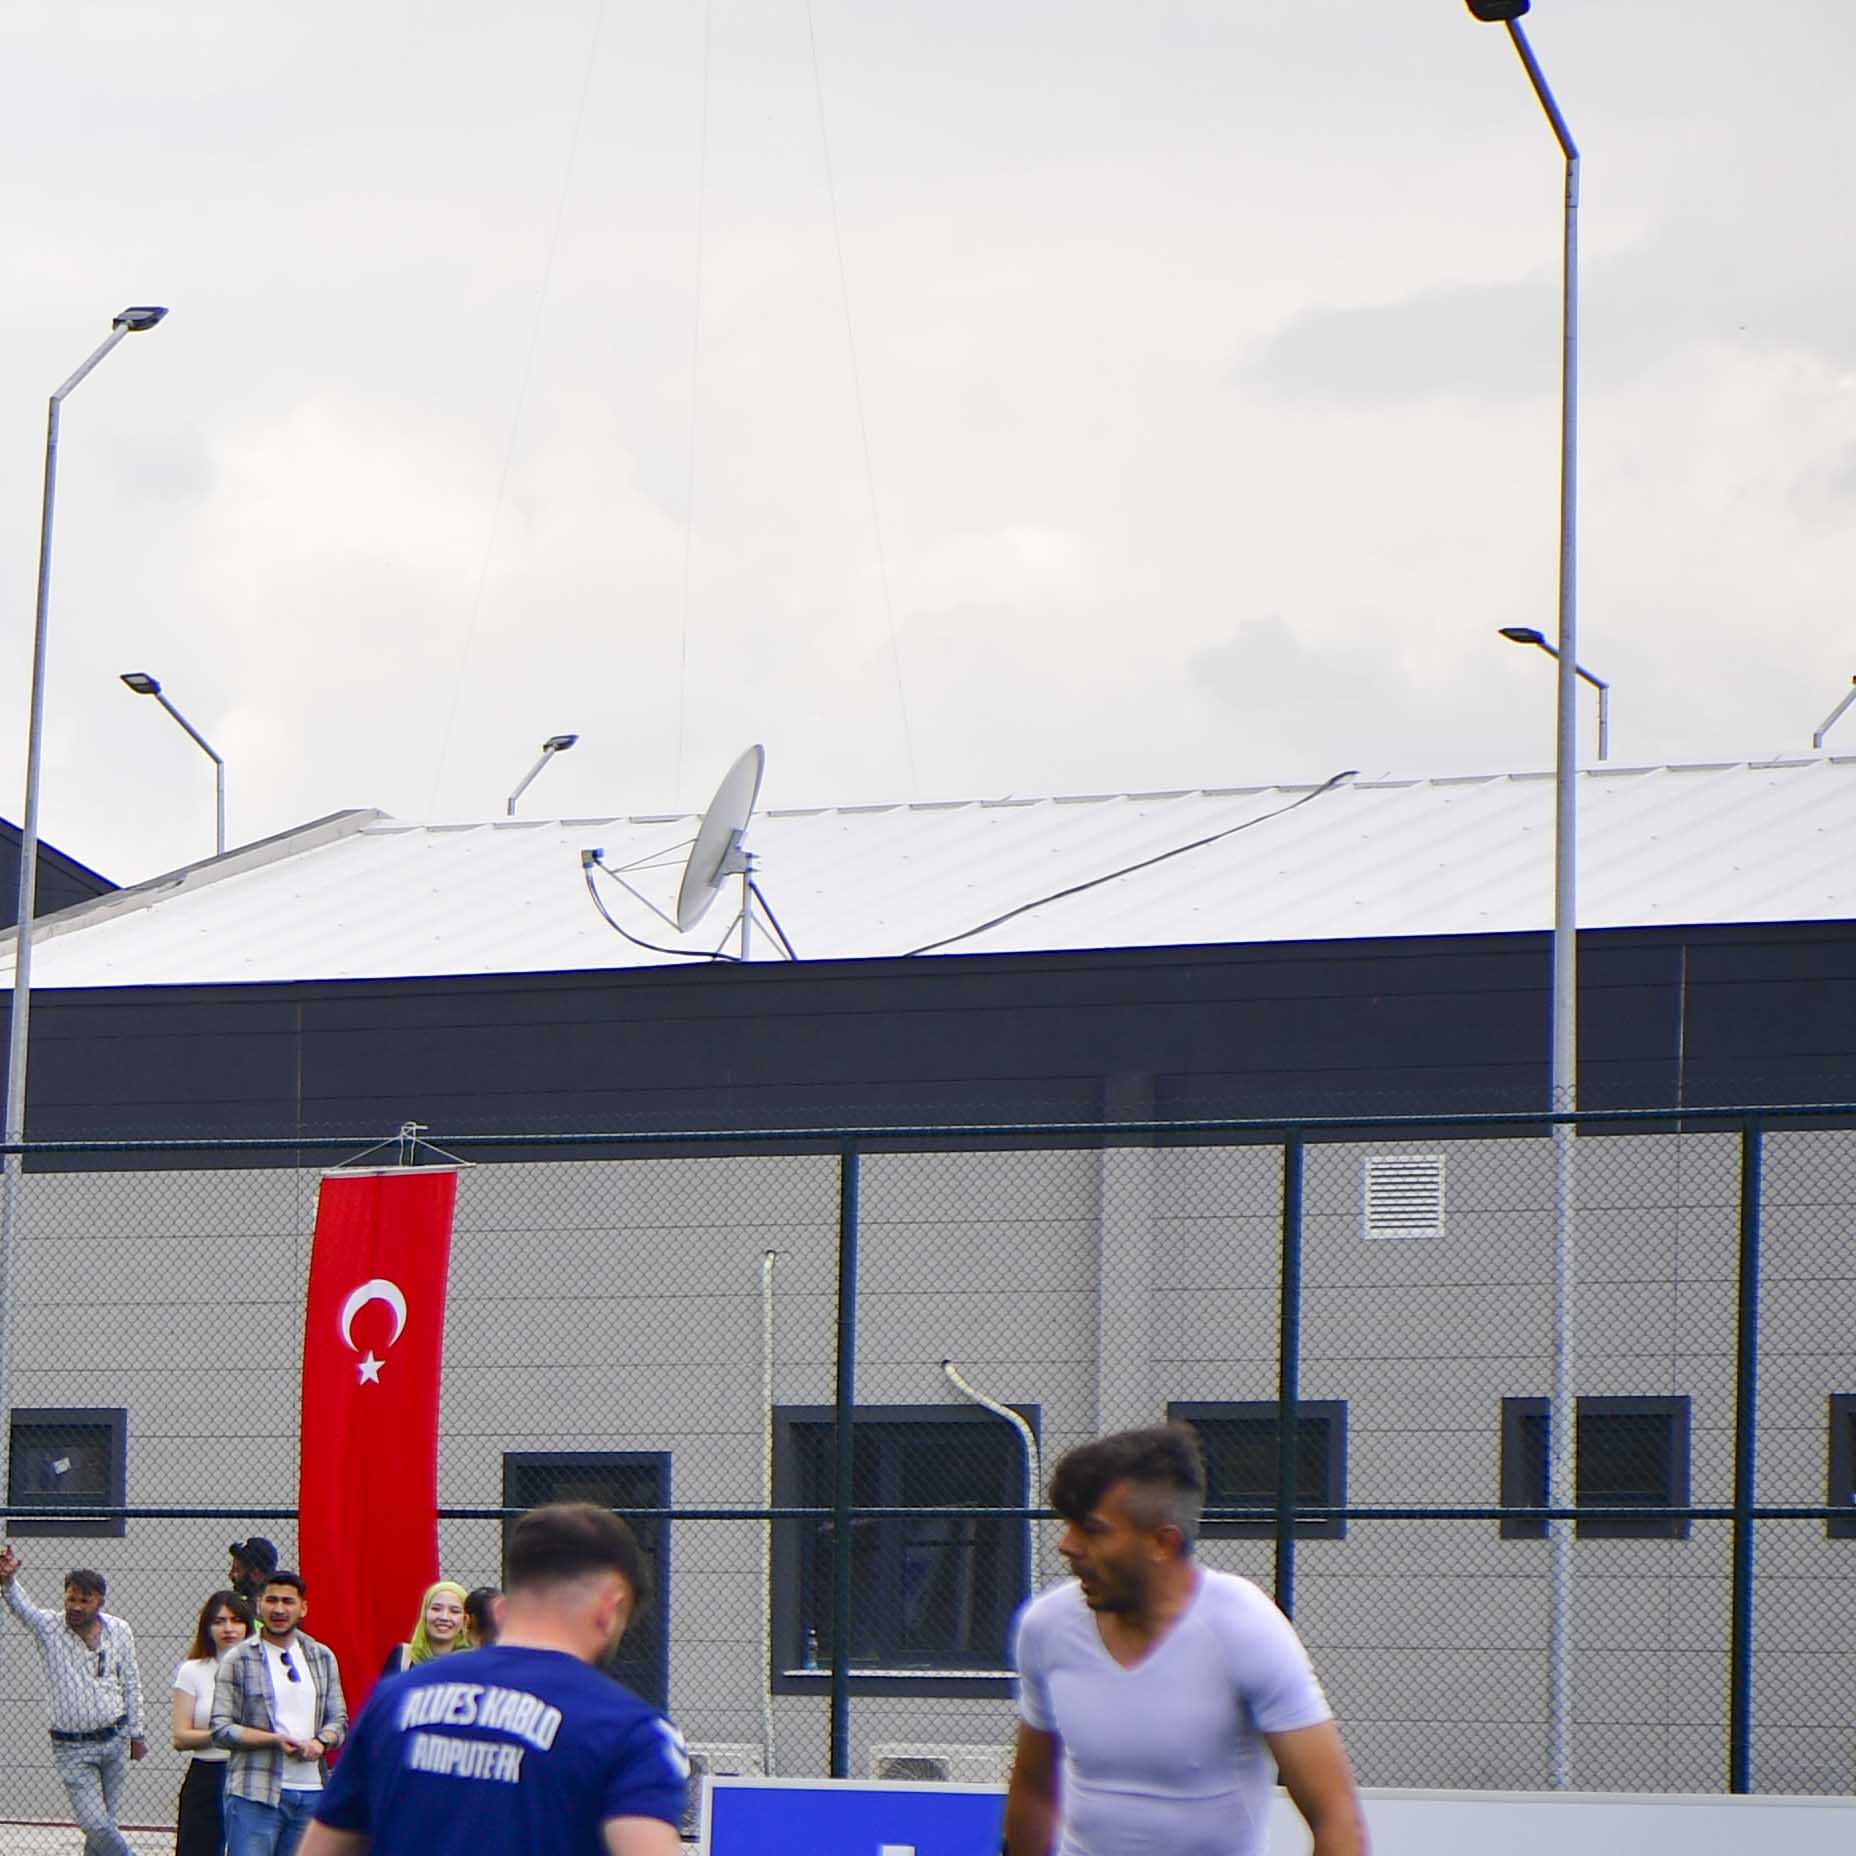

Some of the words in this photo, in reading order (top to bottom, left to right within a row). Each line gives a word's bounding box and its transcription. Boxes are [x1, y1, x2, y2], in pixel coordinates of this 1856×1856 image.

[400, 1682, 485, 1733] ALVES
[478, 1685, 563, 1751] KABLO
[411, 1732, 499, 1780] AMPUTE
